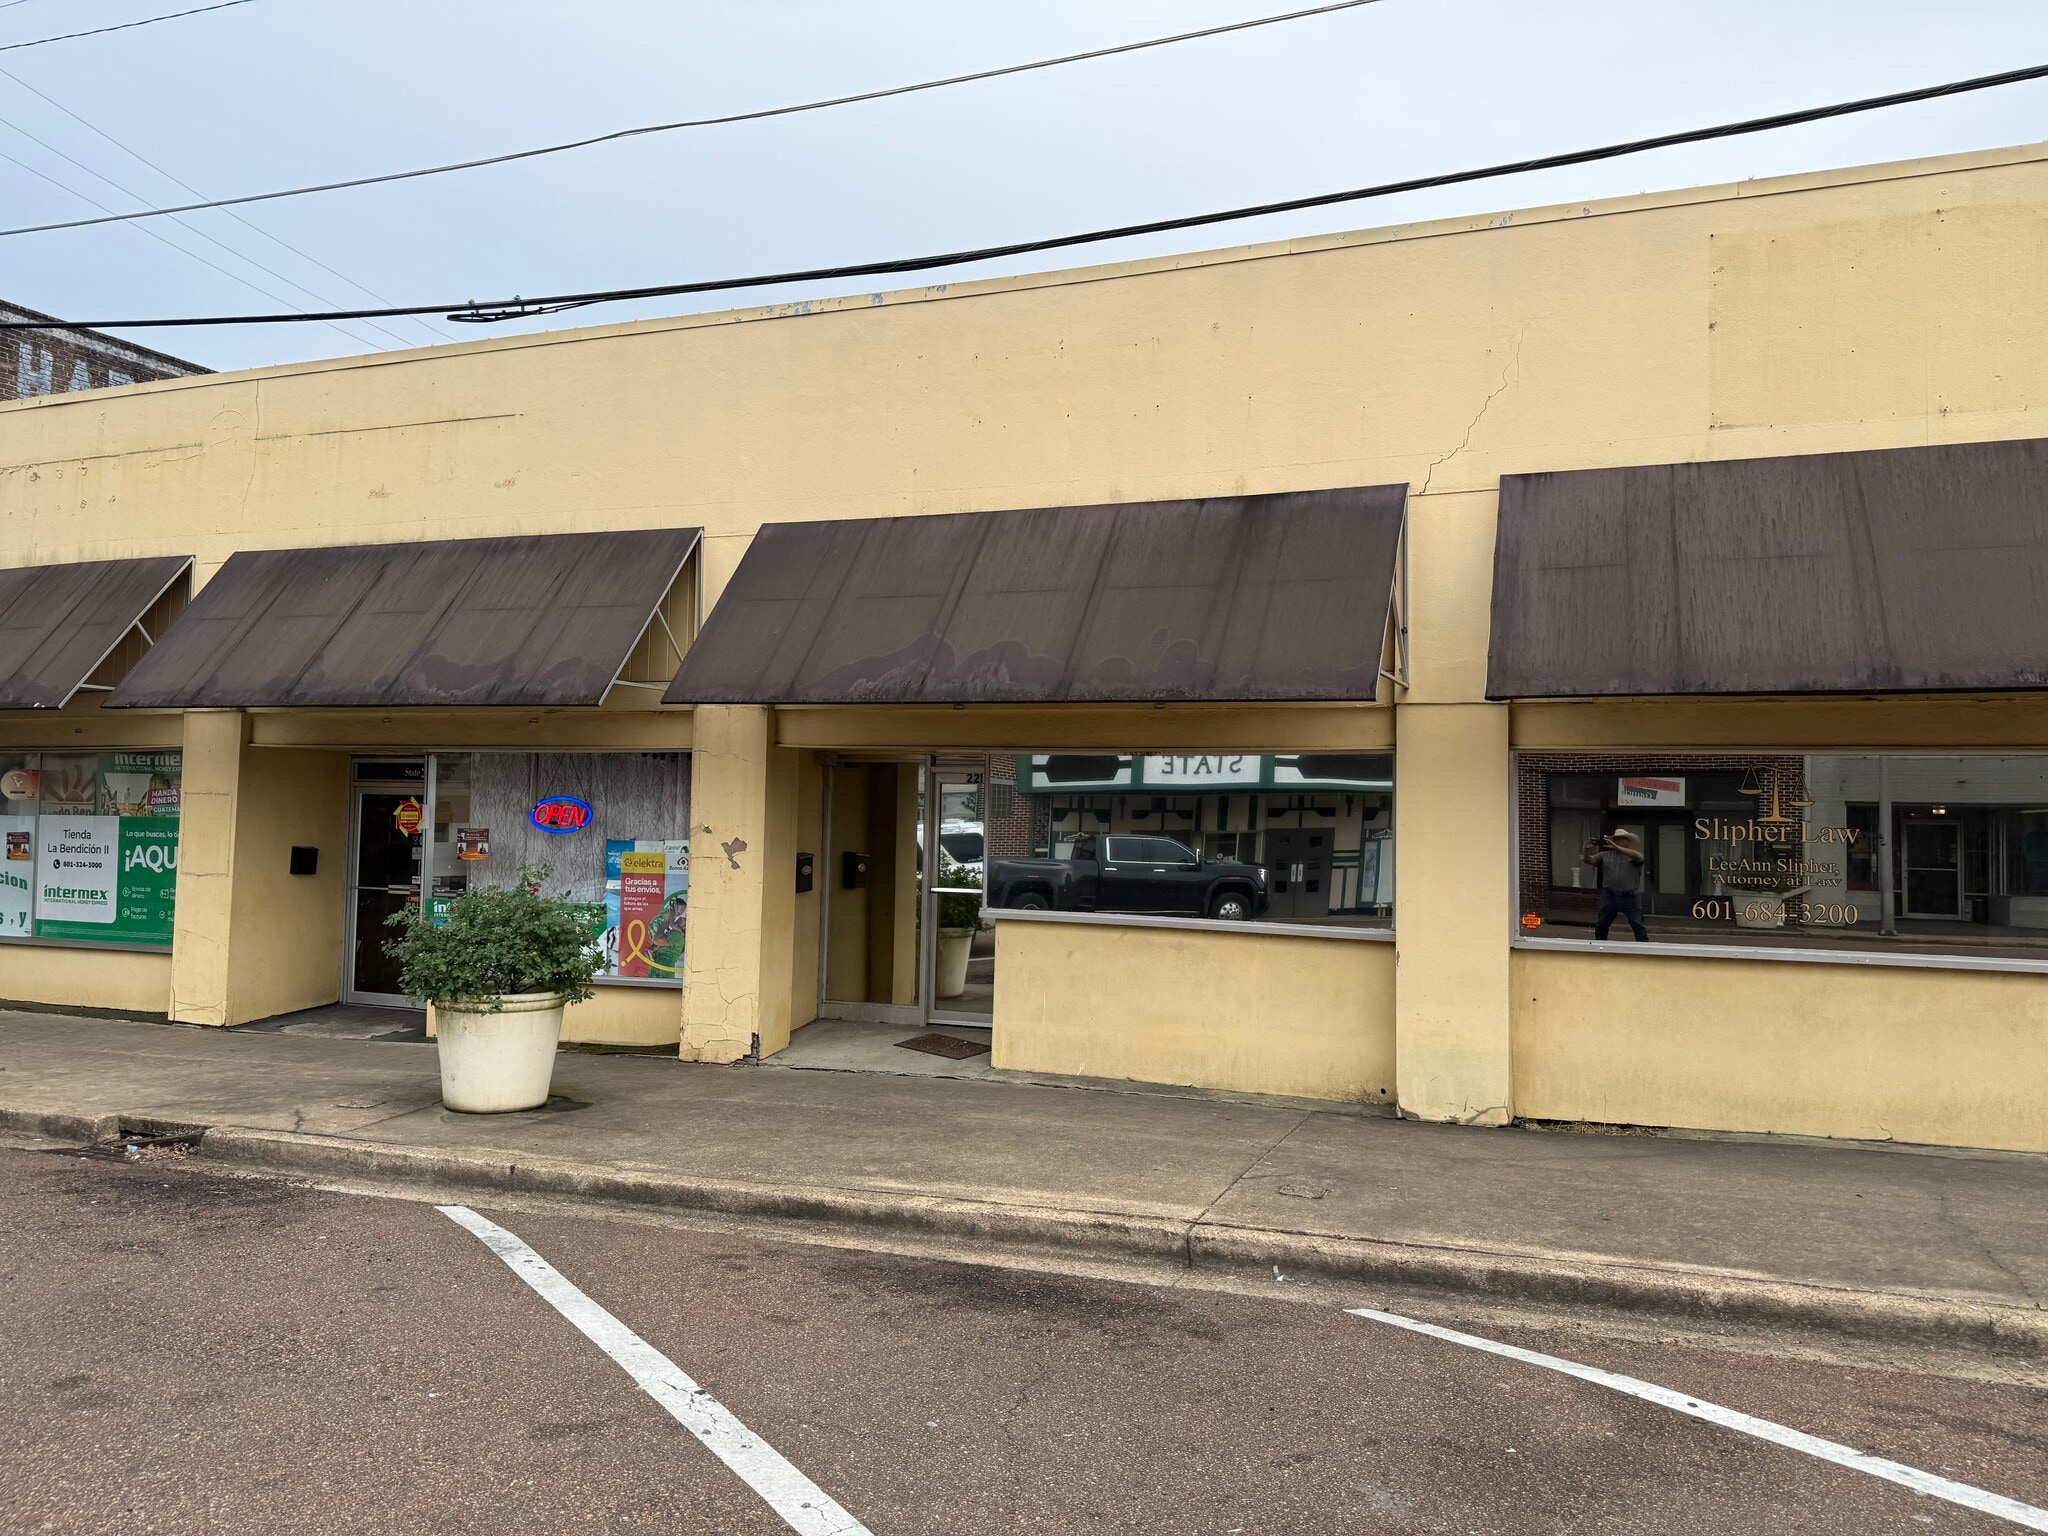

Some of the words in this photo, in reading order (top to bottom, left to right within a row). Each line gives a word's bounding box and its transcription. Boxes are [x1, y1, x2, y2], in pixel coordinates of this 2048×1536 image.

[17, 342, 135, 399] HA
[967, 774, 983, 783] 221
[152, 789, 177, 797] MANDA
[151, 796, 178, 805] DINERO
[534, 804, 587, 828] OPEN
[64, 830, 92, 840] Tienda
[1694, 818, 1790, 847] Slipher
[1801, 821, 1861, 844] Law
[48, 844, 58, 853] La
[60, 844, 101, 854] Bendición
[634, 858, 663, 868] elektra
[1709, 857, 1771, 872] LeeAnn
[1778, 858, 1840, 876] Slipher,
[1713, 874, 1780, 888] Attorney
[1786, 876, 1803, 886] at
[1806, 876, 1842, 887] Law
[1692, 900, 1858, 925] 601-684-3200
